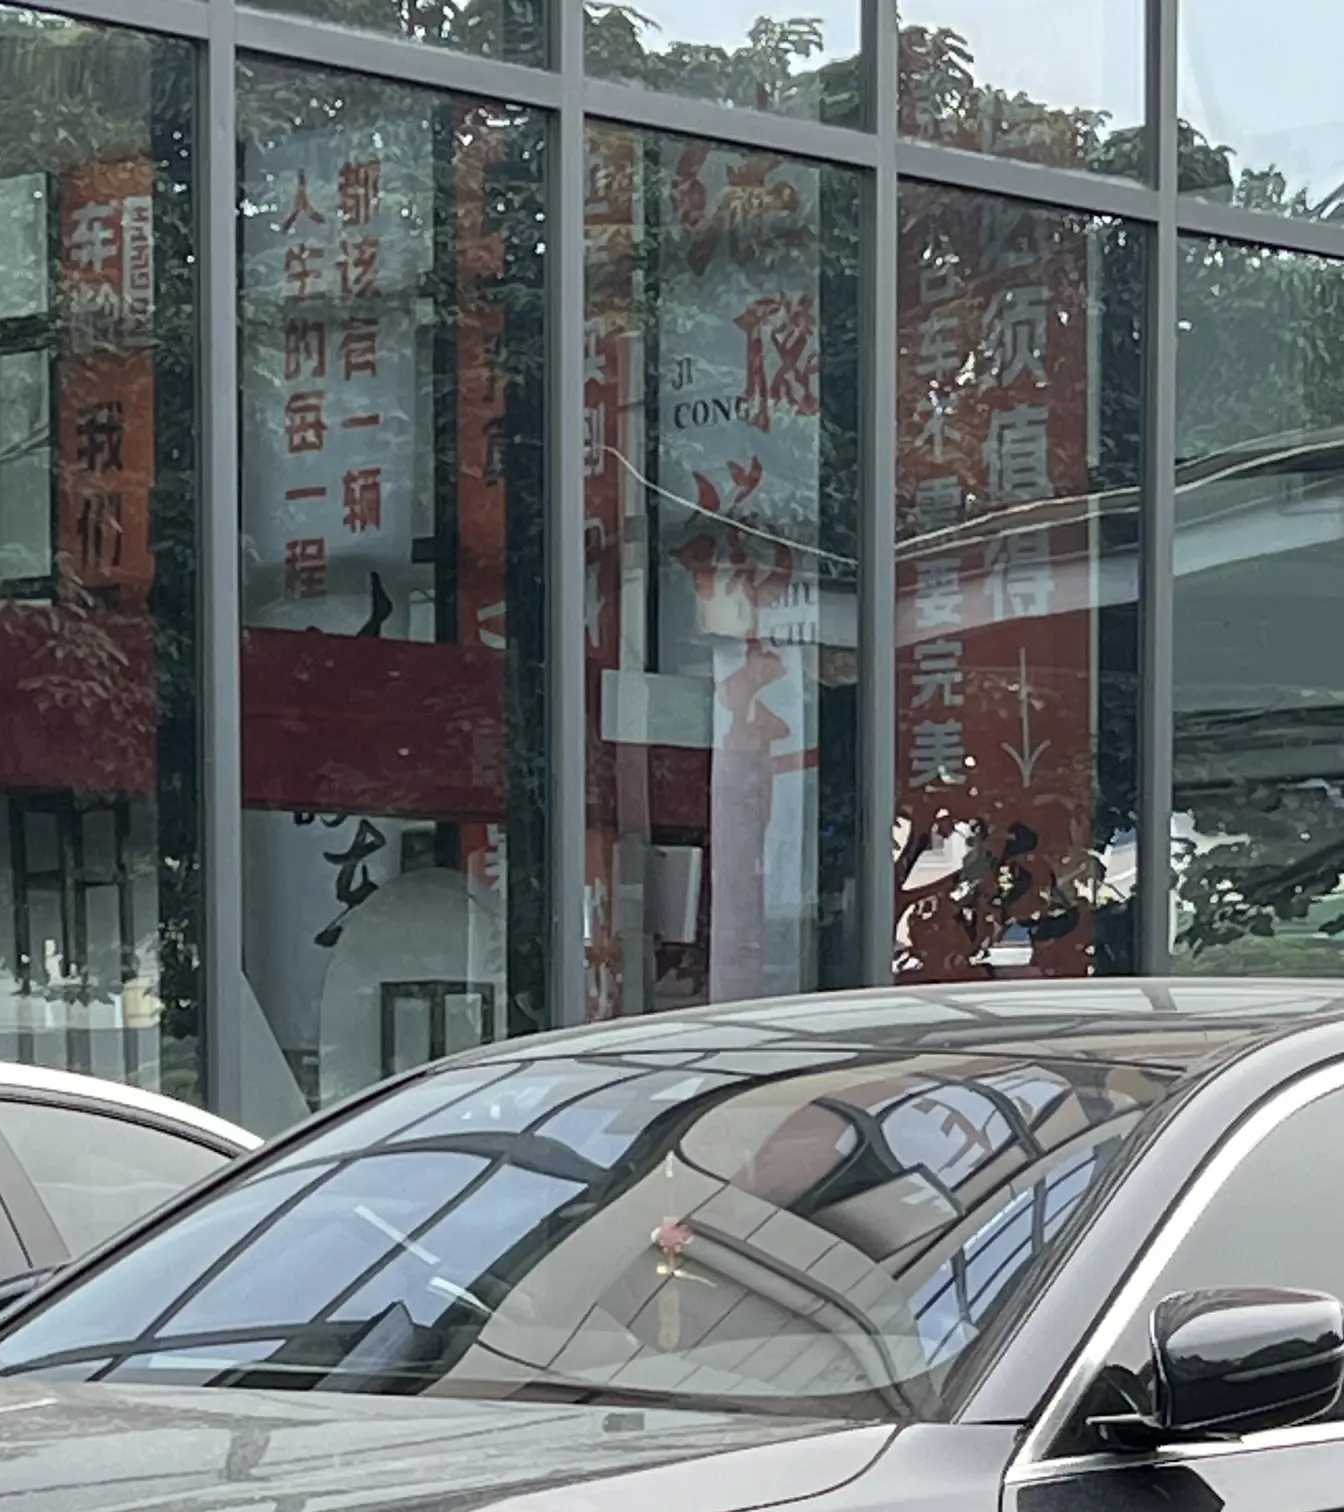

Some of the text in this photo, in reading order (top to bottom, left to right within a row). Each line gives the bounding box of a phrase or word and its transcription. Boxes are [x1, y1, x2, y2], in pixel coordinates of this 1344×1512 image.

[283, 168, 328, 598] 人生的每一程
